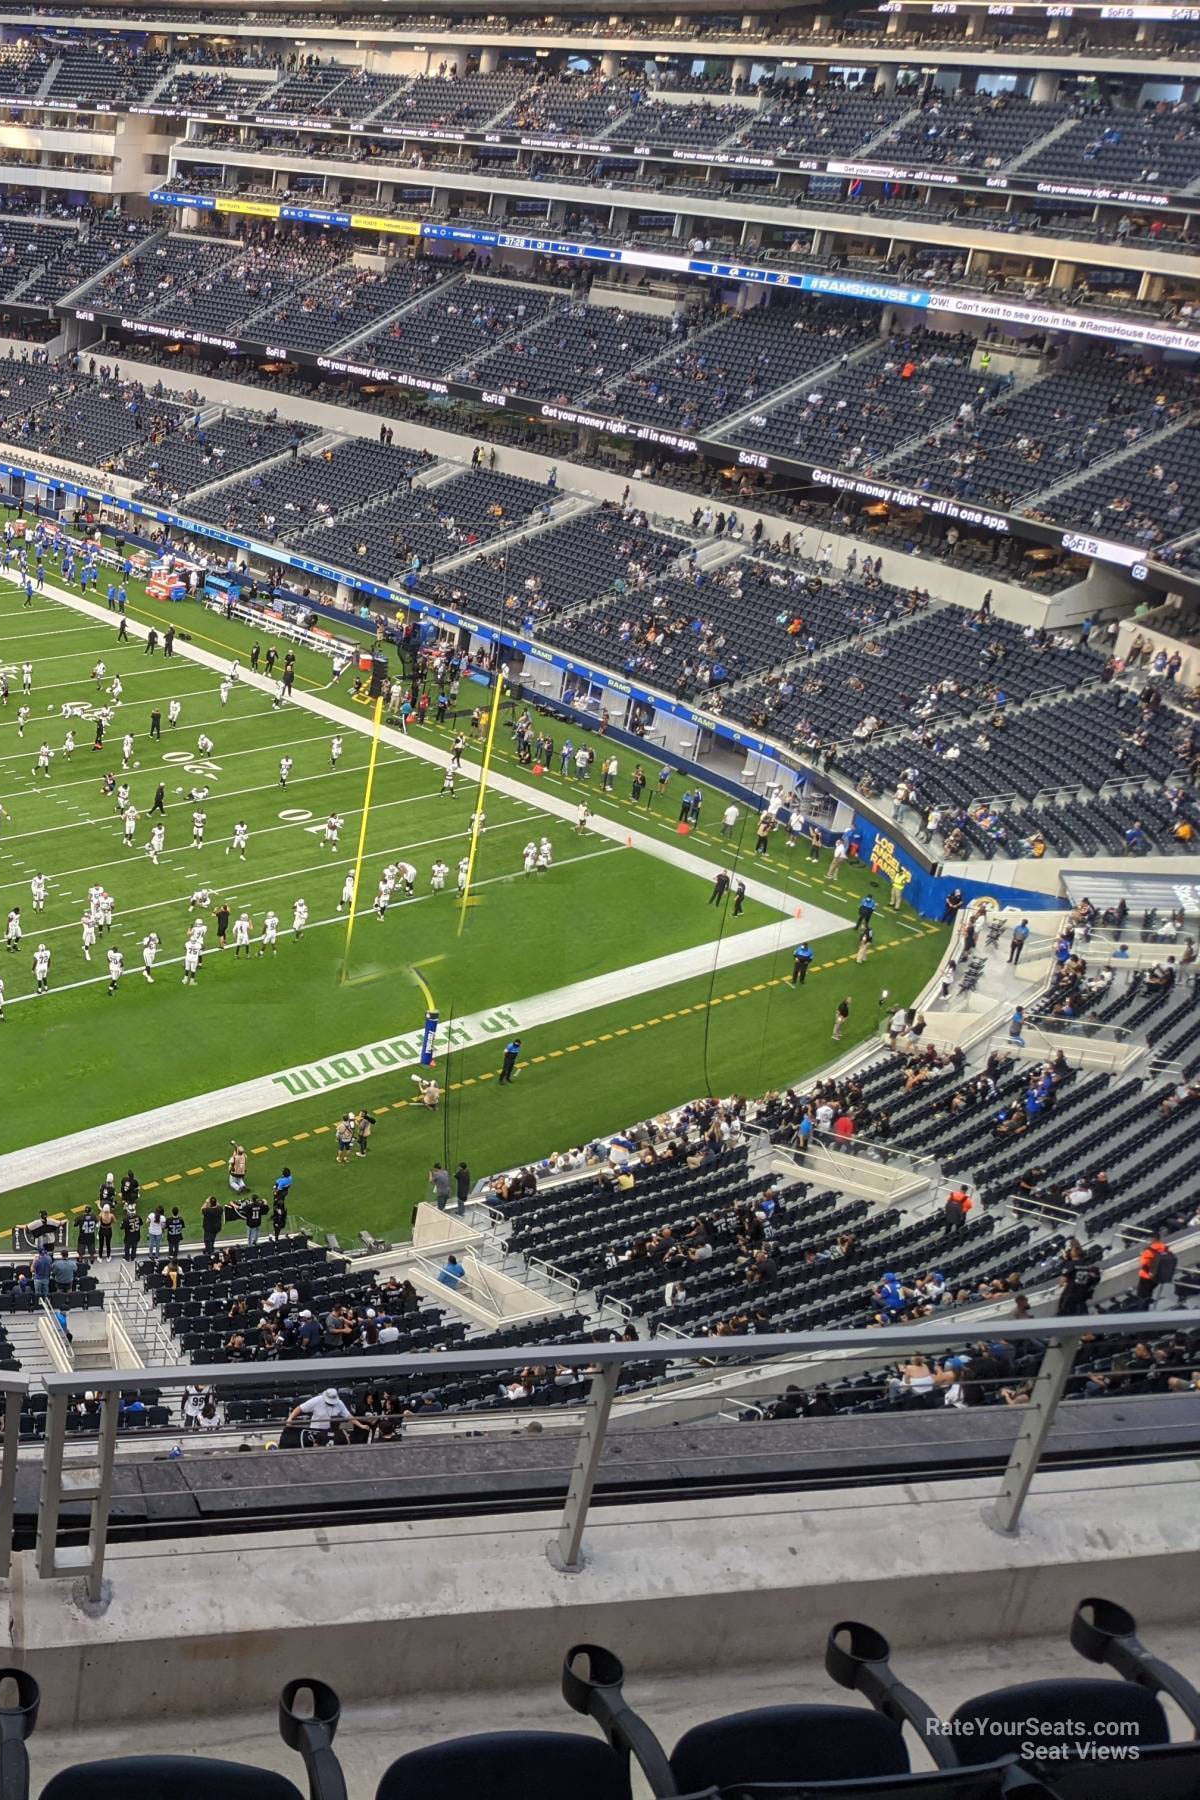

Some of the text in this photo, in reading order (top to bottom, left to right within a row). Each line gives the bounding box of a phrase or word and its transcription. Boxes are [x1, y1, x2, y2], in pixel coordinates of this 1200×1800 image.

[810, 278, 907, 301] #RAMSHOUSE
[76, 311, 88, 320] SoFi
[956, 301, 980, 313] Can't
[984, 305, 1000, 317] wait
[1002, 308, 1012, 318] to
[1014, 312, 1029, 321] see
[1032, 315, 1048, 326] you
[1050, 315, 1059, 324] in
[1062, 317, 1077, 328] the
[1080, 320, 1143, 338] #RamsHouse
[1146, 331, 1182, 346] tonight
[122, 319, 133, 328] Get
[134, 323, 148, 331] your
[149, 326, 169, 336] money
[202, 334, 208, 343] in
[224, 340, 237, 349] app.
[266, 347, 279, 357] SoFi
[317, 354, 330, 367] Get
[331, 362, 346, 371] your
[347, 364, 371, 377] money
[398, 375, 407, 384] all
[409, 376, 415, 385] in
[416, 380, 431, 389] one
[432, 383, 448, 393] app.
[482, 392, 497, 403] SoFi
[542, 405, 557, 417] Get
[558, 410, 577, 422] your
[578, 414, 605, 429] money
[637, 428, 648, 438] all
[650, 429, 658, 440] in
[660, 434, 676, 445] one
[678, 439, 697, 451] app.
[739, 451, 758, 467] SoFi
[812, 470, 831, 484] Get
[856, 482, 890, 500] money
[932, 501, 944, 514] all
[947, 503, 958, 517] in
[960, 509, 981, 523] one
[984, 515, 1009, 530] app.
[390, 593, 410, 606] RAMS
[458, 619, 478, 632] RAMS
[531, 646, 553, 661] RAMS
[608, 679, 631, 694] RAMS
[691, 714, 716, 730] RAMS
[875, 833, 894, 854] LOS
[39, 956, 48, 964] 72
[81, 1222, 95, 1233] 42
[129, 1222, 139, 1232] 35
[168, 1225, 182, 1234] 32
